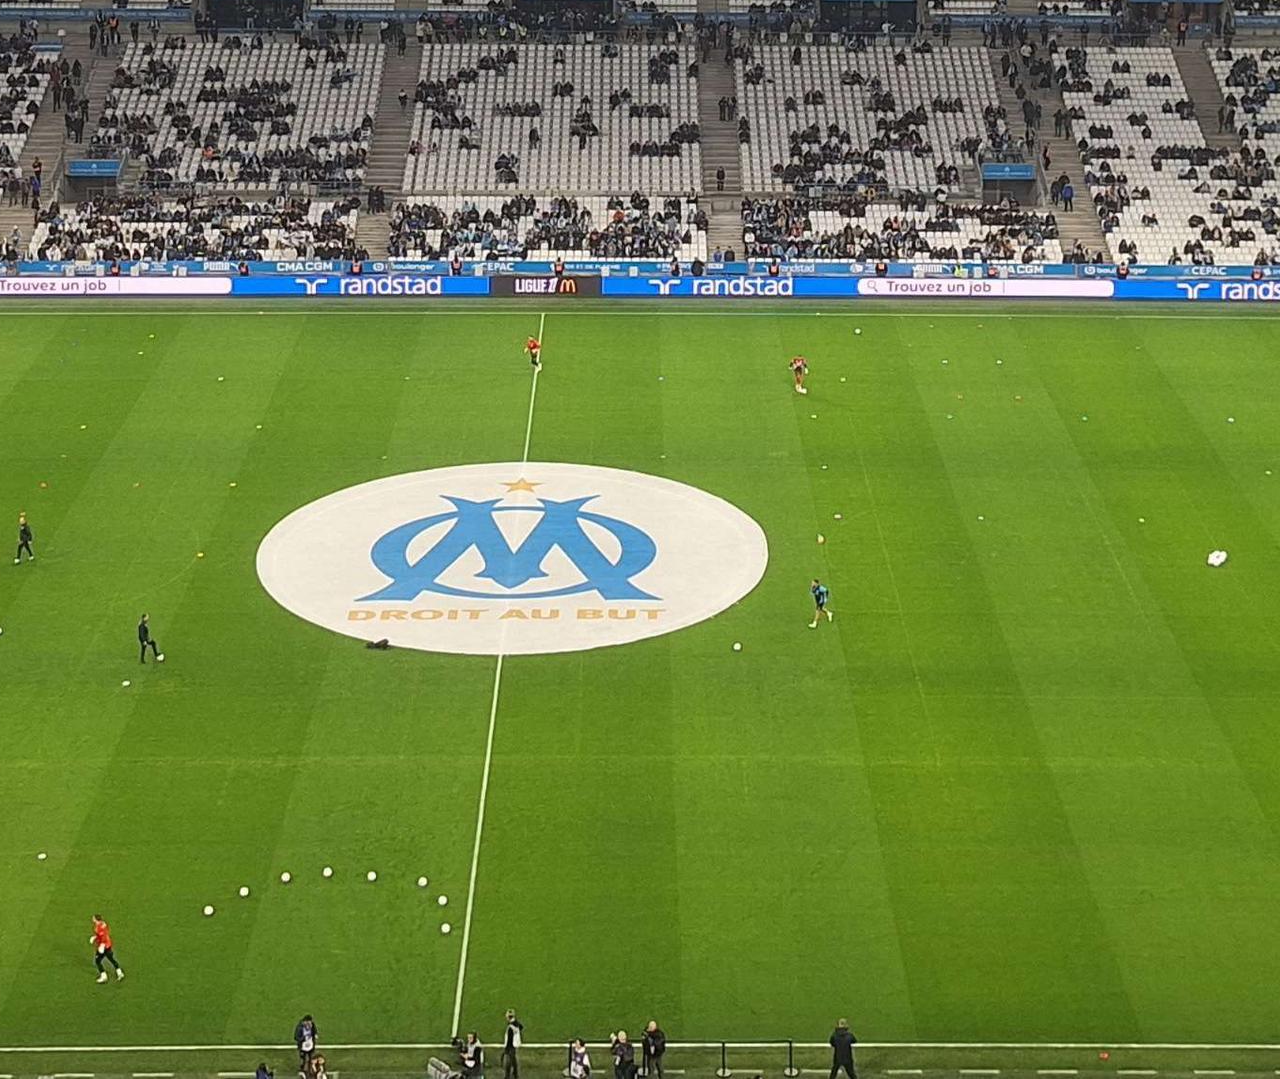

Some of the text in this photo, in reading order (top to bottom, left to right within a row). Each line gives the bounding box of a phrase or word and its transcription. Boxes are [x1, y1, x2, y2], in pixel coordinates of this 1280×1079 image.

[276, 262, 333, 271] CMA CGM
[1191, 267, 1227, 275] CEPAC
[0, 280, 107, 296] Trouvez un job
[340, 275, 442, 295] randstad
[692, 276, 793, 296] randstad
[887, 281, 942, 292] Trouvez
[947, 284, 965, 293] un
[347, 609, 668, 621] DROIT AU BUT
